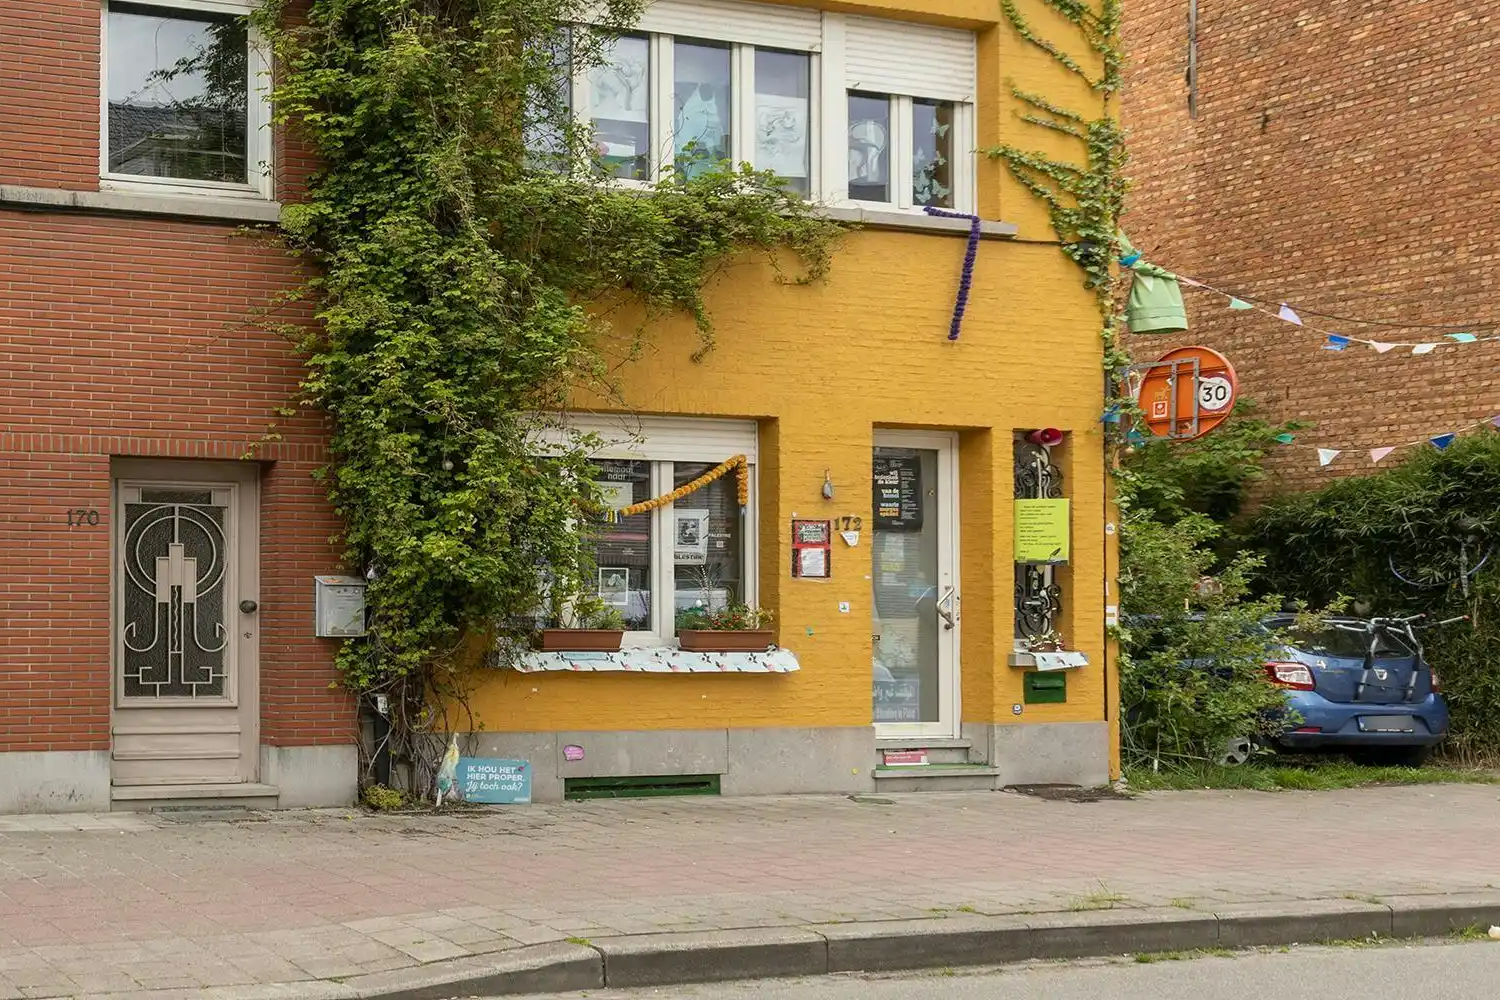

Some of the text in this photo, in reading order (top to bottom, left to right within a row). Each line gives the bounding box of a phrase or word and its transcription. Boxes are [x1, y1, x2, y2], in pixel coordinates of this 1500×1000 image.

[1202, 385, 1227, 402] 30
[67, 509, 99, 526] 170
[834, 516, 862, 531] 172
[467, 765, 516, 774] IK HOU HET
[466, 773, 486, 781] HIER
[480, 781, 499, 790] toch
[501, 782, 523, 792] ook?
